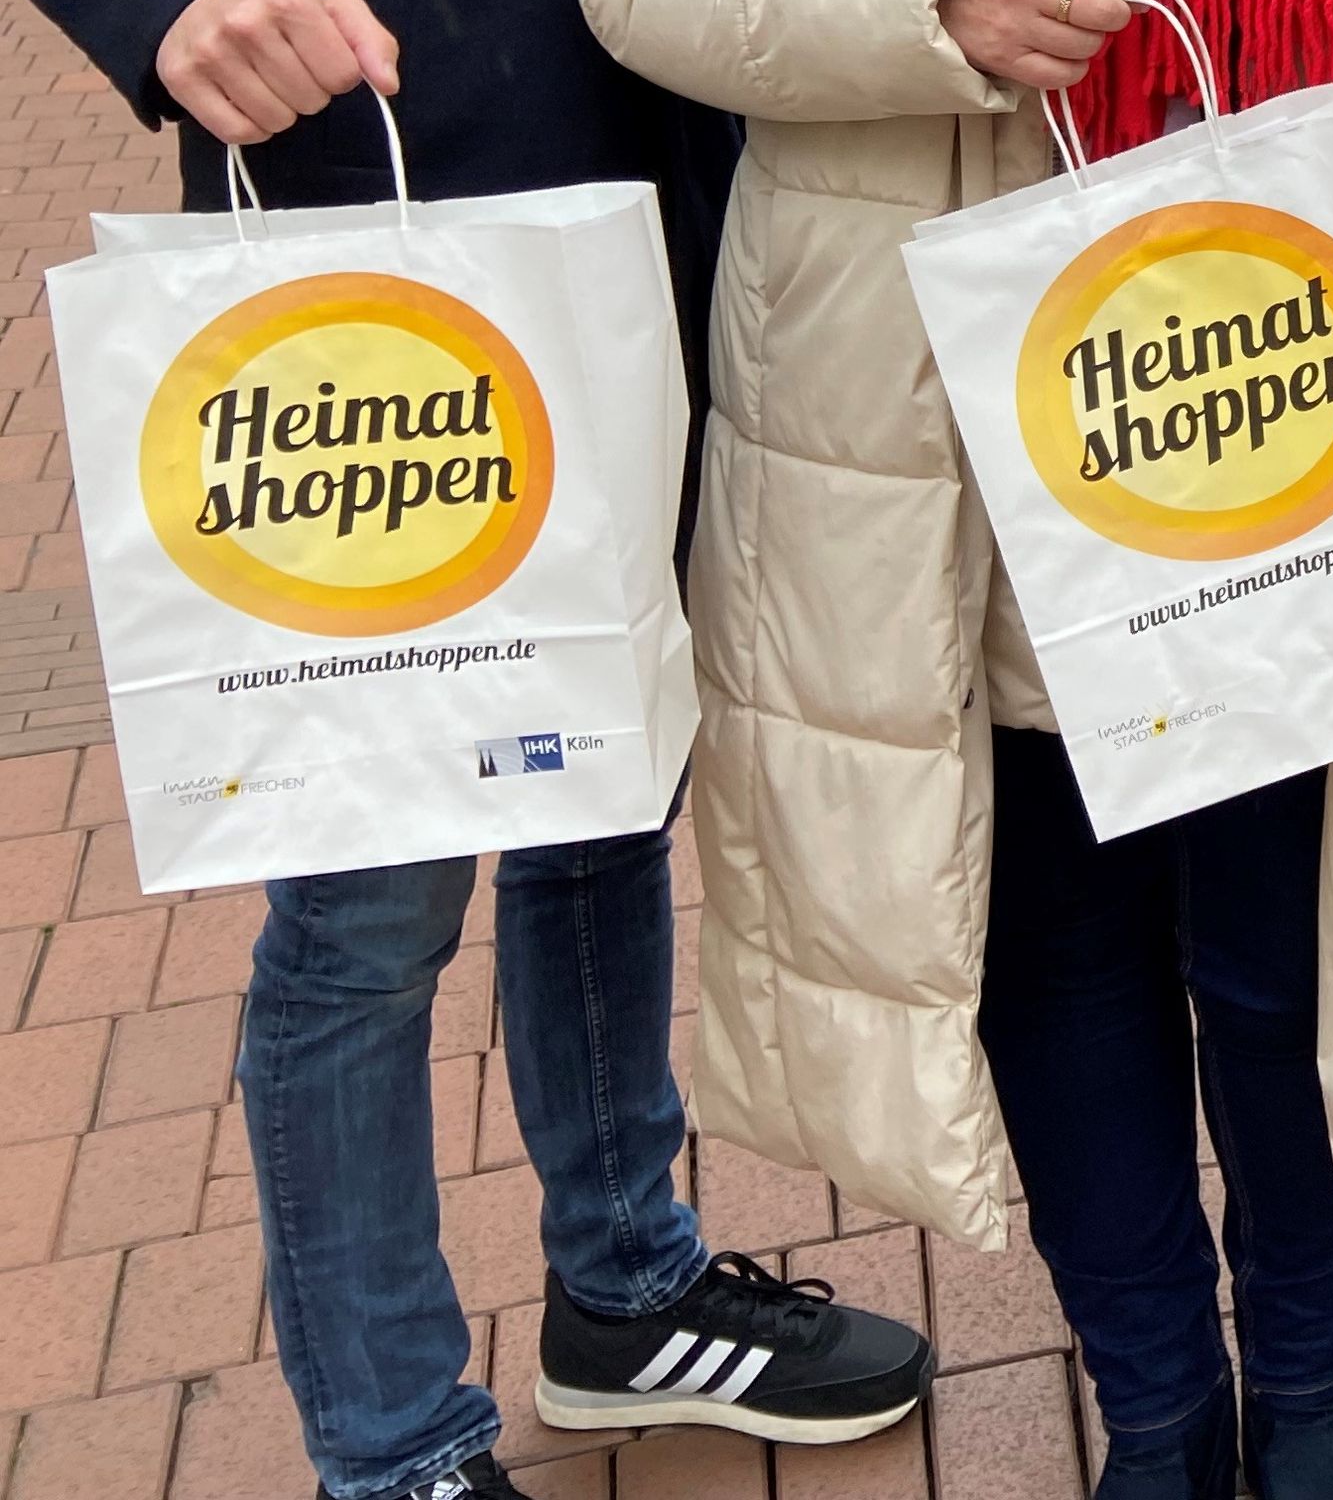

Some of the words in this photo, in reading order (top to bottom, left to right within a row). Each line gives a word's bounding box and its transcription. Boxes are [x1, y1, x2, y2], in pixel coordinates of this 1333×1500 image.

[1062, 275, 1333, 413] Heimat
[198, 373, 497, 465] Heimat
[194, 455, 518, 539] shoppen
[217, 638, 536, 695] www.heimatshoppen.de
[523, 738, 559, 756] IHK
[566, 735, 604, 752] Köln
[1097, 713, 1152, 740] Innen
[1113, 726, 1155, 751] STADT
[1167, 701, 1227, 730] FRECHEN
[163, 774, 224, 795] Innen
[177, 787, 225, 807] STADT
[240, 776, 306, 795] FRECHEN
